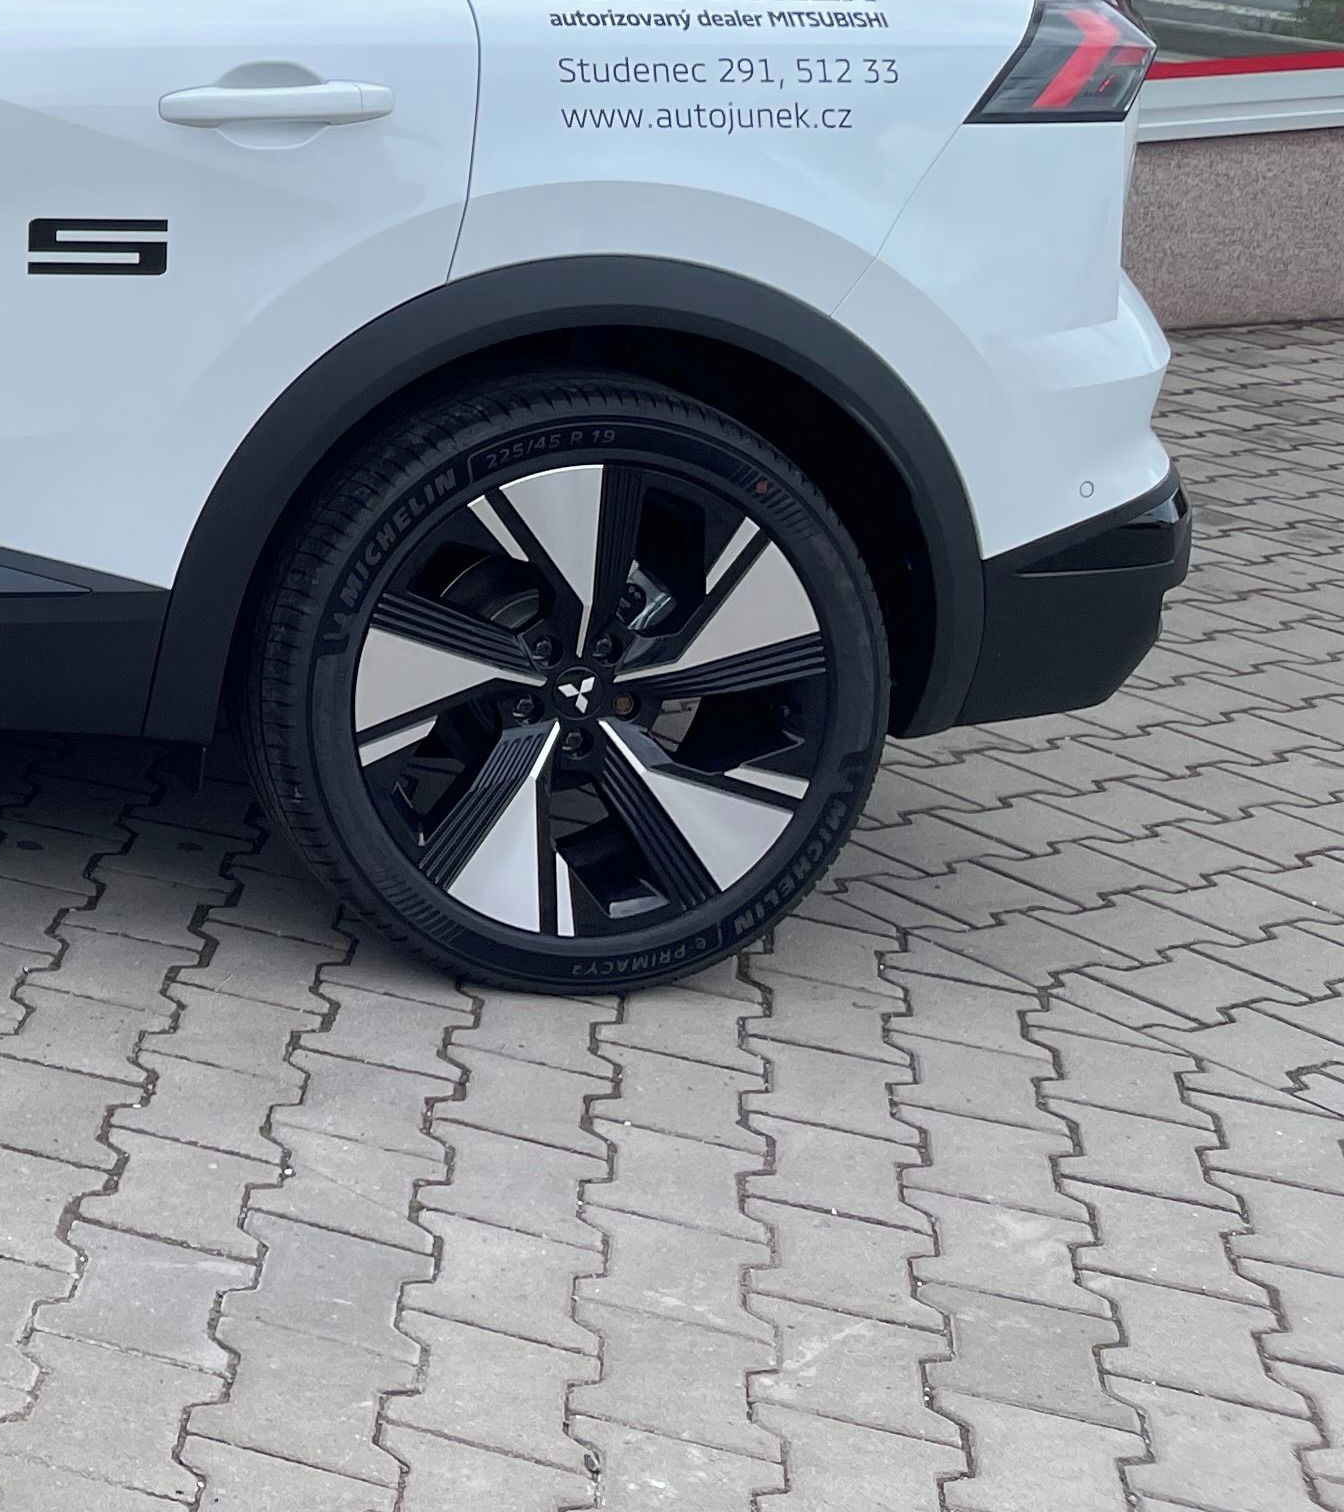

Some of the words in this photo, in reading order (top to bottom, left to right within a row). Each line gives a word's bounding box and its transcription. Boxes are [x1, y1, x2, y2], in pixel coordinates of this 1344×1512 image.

[549, 9, 691, 31] autorizovaný
[697, 9, 763, 28] dealer
[767, 11, 889, 29] MITSUBISHI
[558, 56, 707, 83] Studenec
[718, 57, 784, 90] 291,
[796, 58, 852, 84] 512
[862, 58, 899, 84] 33
[560, 102, 853, 135] www.autojunek.cz
[338, 466, 457, 609] MICHELIN
[485, 432, 561, 470] 225/45
[570, 430, 584, 445] R
[591, 428, 616, 444] 19
[733, 798, 848, 935] MICHELIN
